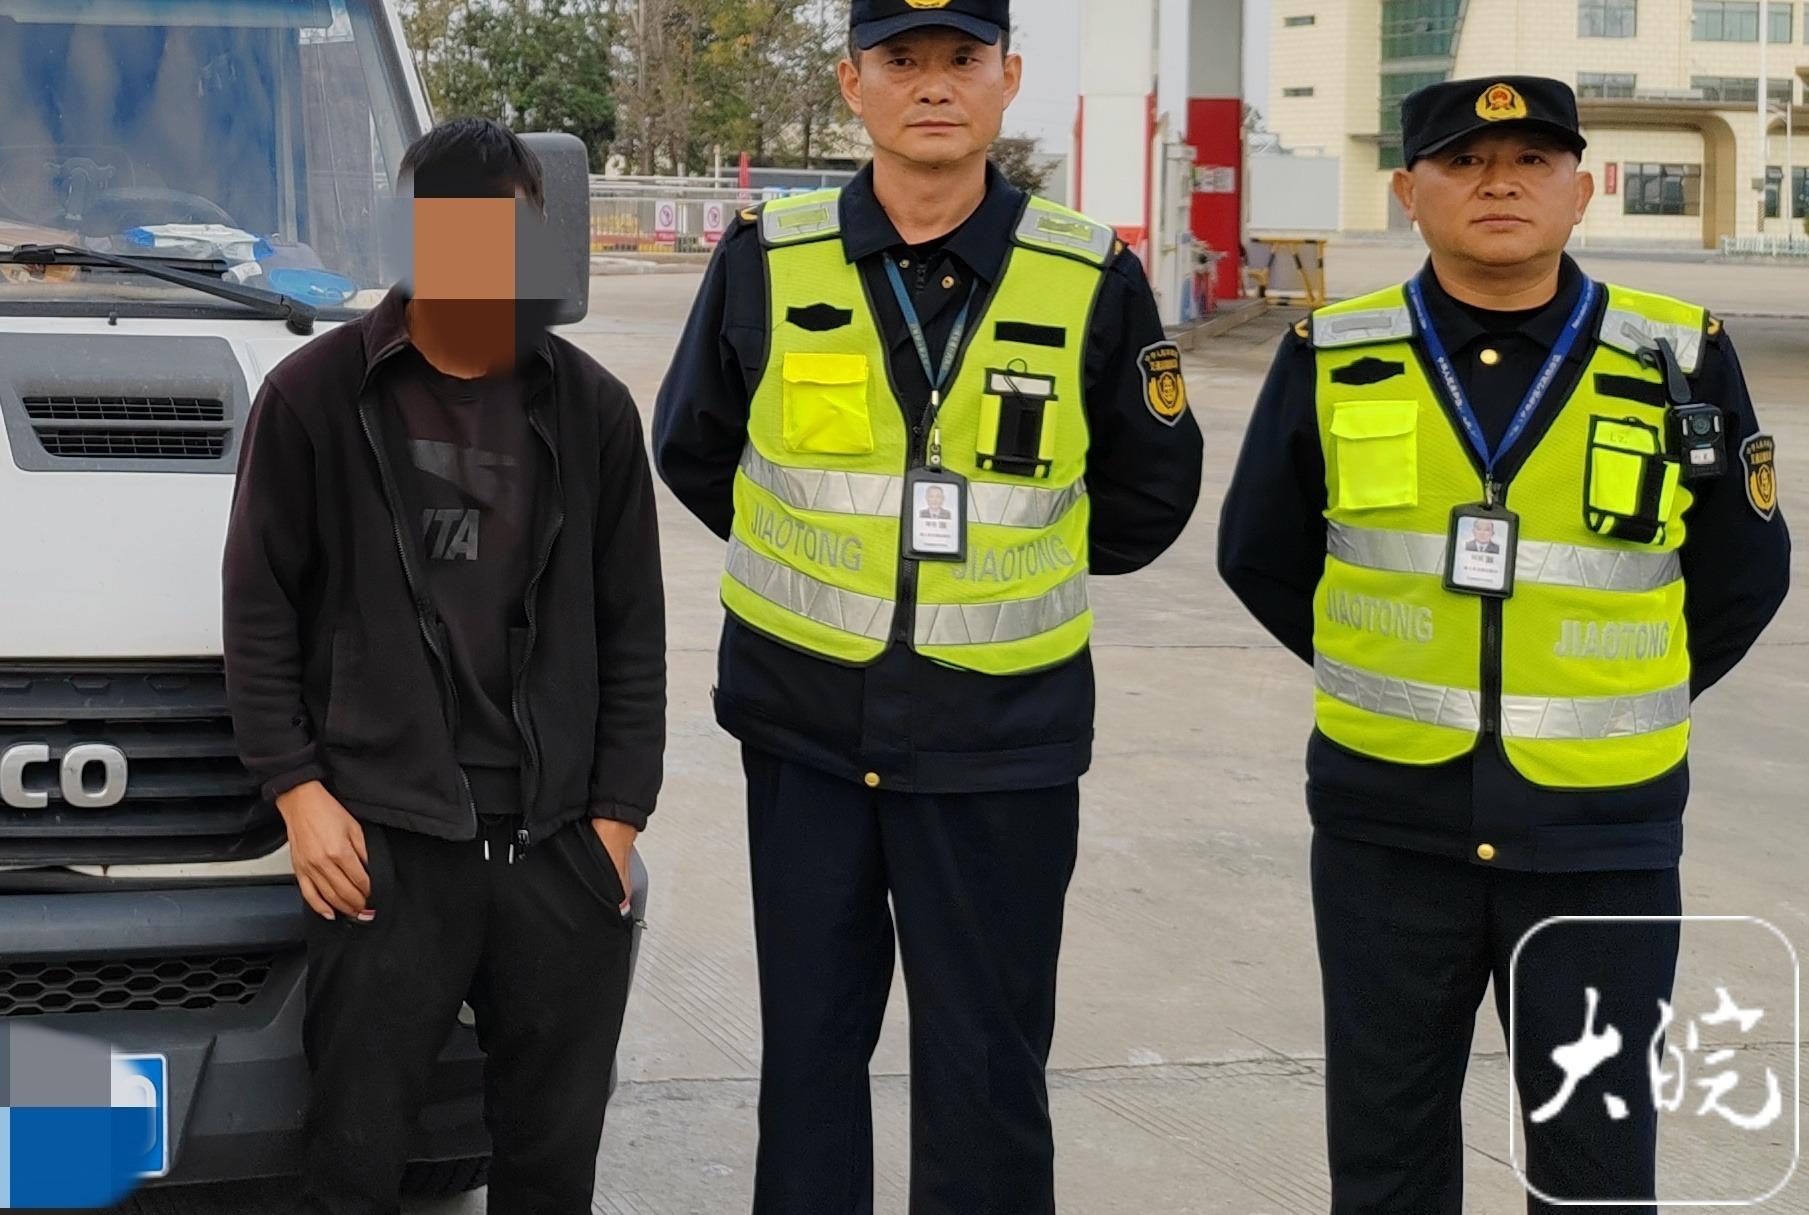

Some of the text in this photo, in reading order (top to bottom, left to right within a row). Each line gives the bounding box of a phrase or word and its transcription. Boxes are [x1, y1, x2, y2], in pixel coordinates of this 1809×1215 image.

[750, 503, 863, 572] JIAOTONG
[1326, 586, 1434, 644] JIAOTONG
[1554, 619, 1670, 660] JIAOTONG
